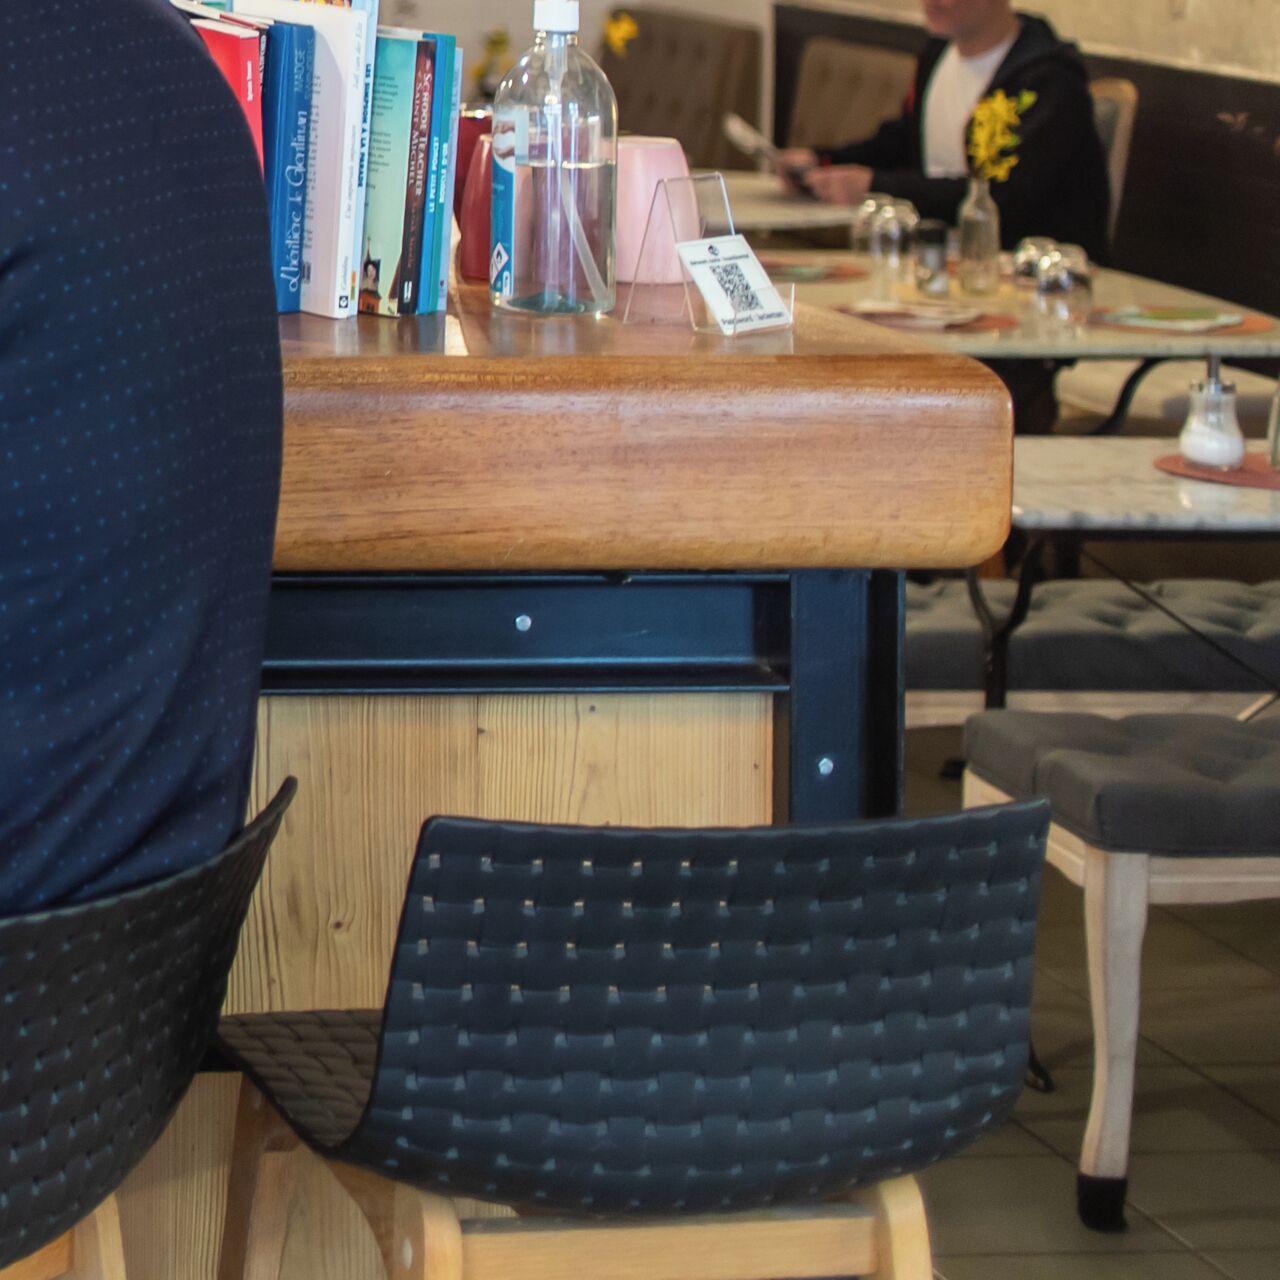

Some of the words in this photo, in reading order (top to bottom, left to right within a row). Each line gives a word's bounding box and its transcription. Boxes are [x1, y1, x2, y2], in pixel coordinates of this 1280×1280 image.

[293, 49, 306, 93] MADGE
[362, 82, 371, 125] SIMPSON
[360, 137, 367, 148] LA
[430, 136, 440, 171] POUCET
[357, 152, 366, 188] PARADE
[415, 135, 428, 196] TEACHER
[428, 174, 438, 200] PETIT
[438, 169, 448, 204] BOUCLE
[428, 202, 436, 213] LE
